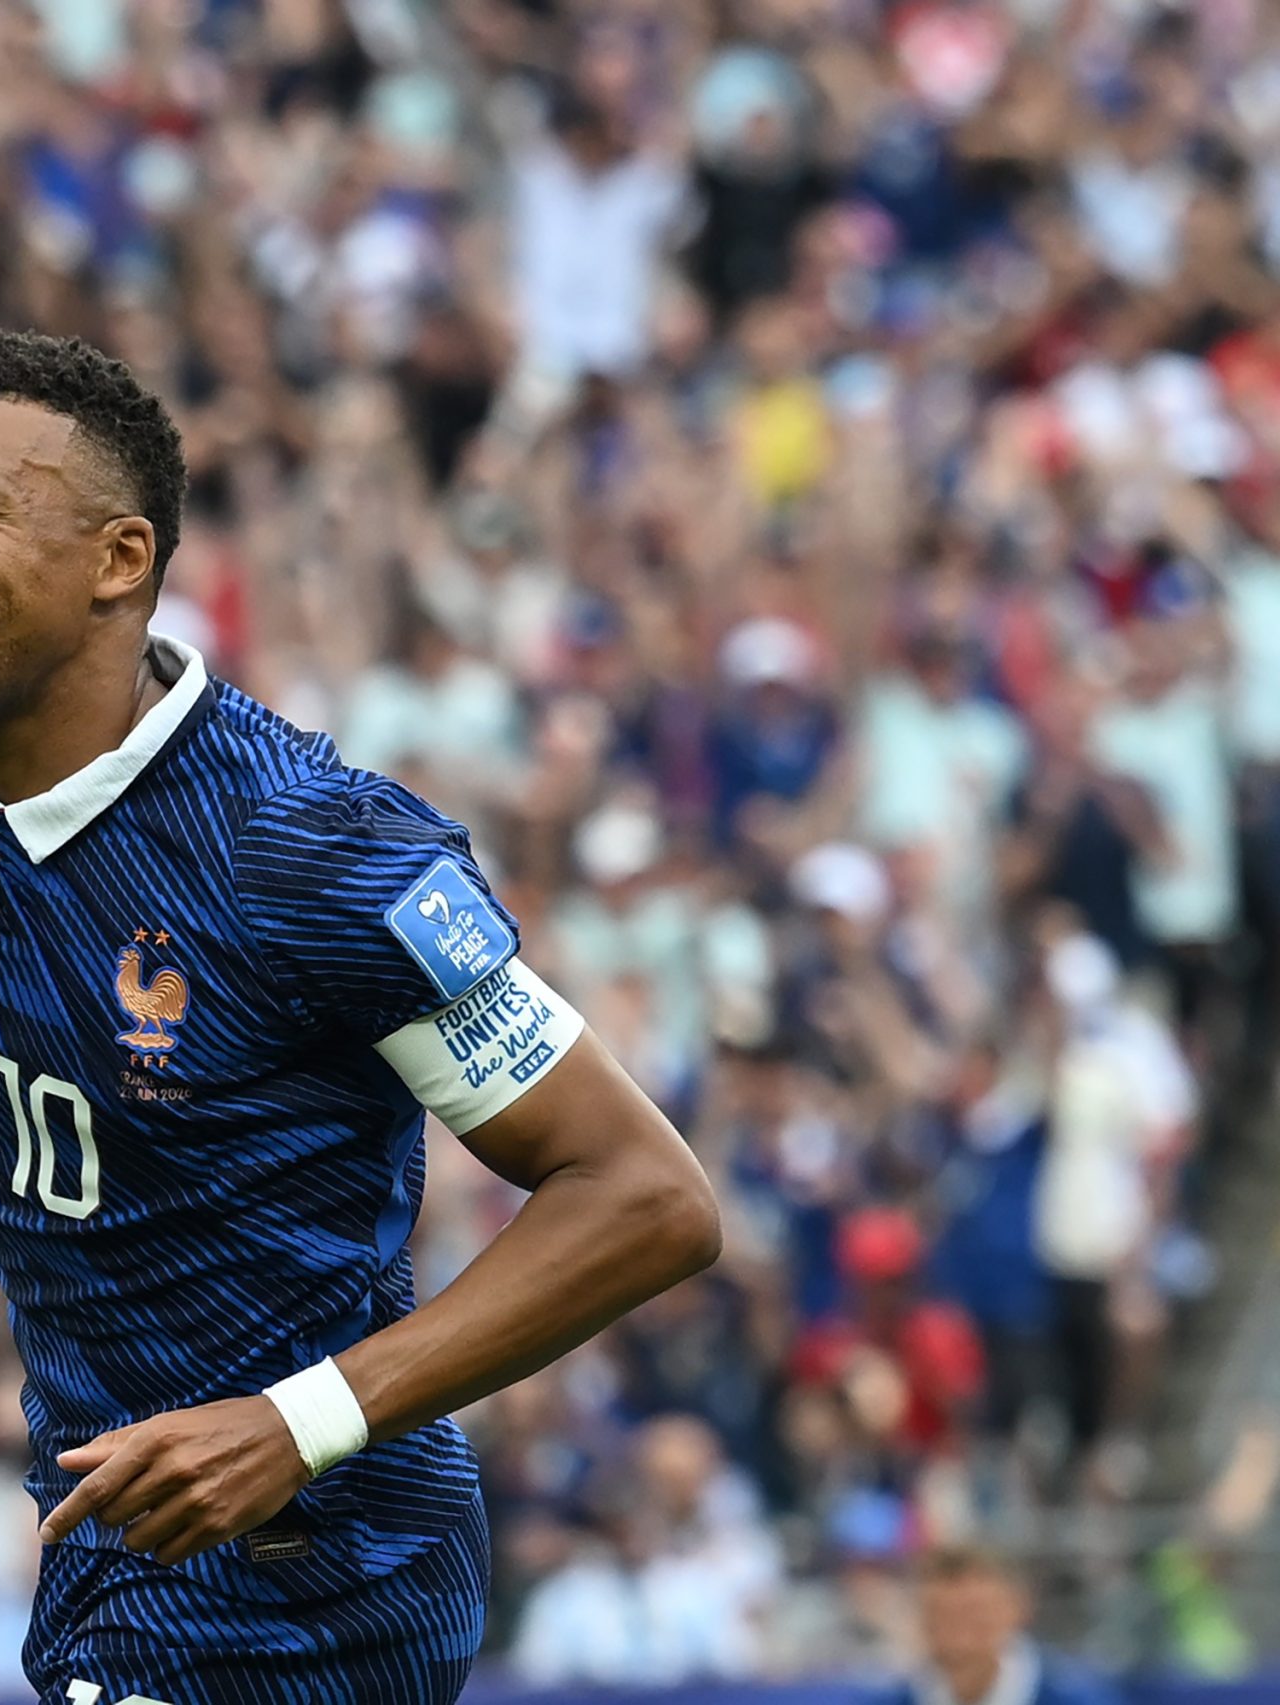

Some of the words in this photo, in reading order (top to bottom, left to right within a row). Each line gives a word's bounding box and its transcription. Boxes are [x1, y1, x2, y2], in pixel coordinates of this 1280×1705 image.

[448, 926, 489, 971] PEACE
[468, 952, 492, 975] FIFA
[433, 966, 511, 1038] FOOTBALL
[445, 981, 531, 1062] UNITES
[461, 1055, 503, 1089] the
[497, 997, 556, 1059] World
[514, 1047, 552, 1079] FIFA
